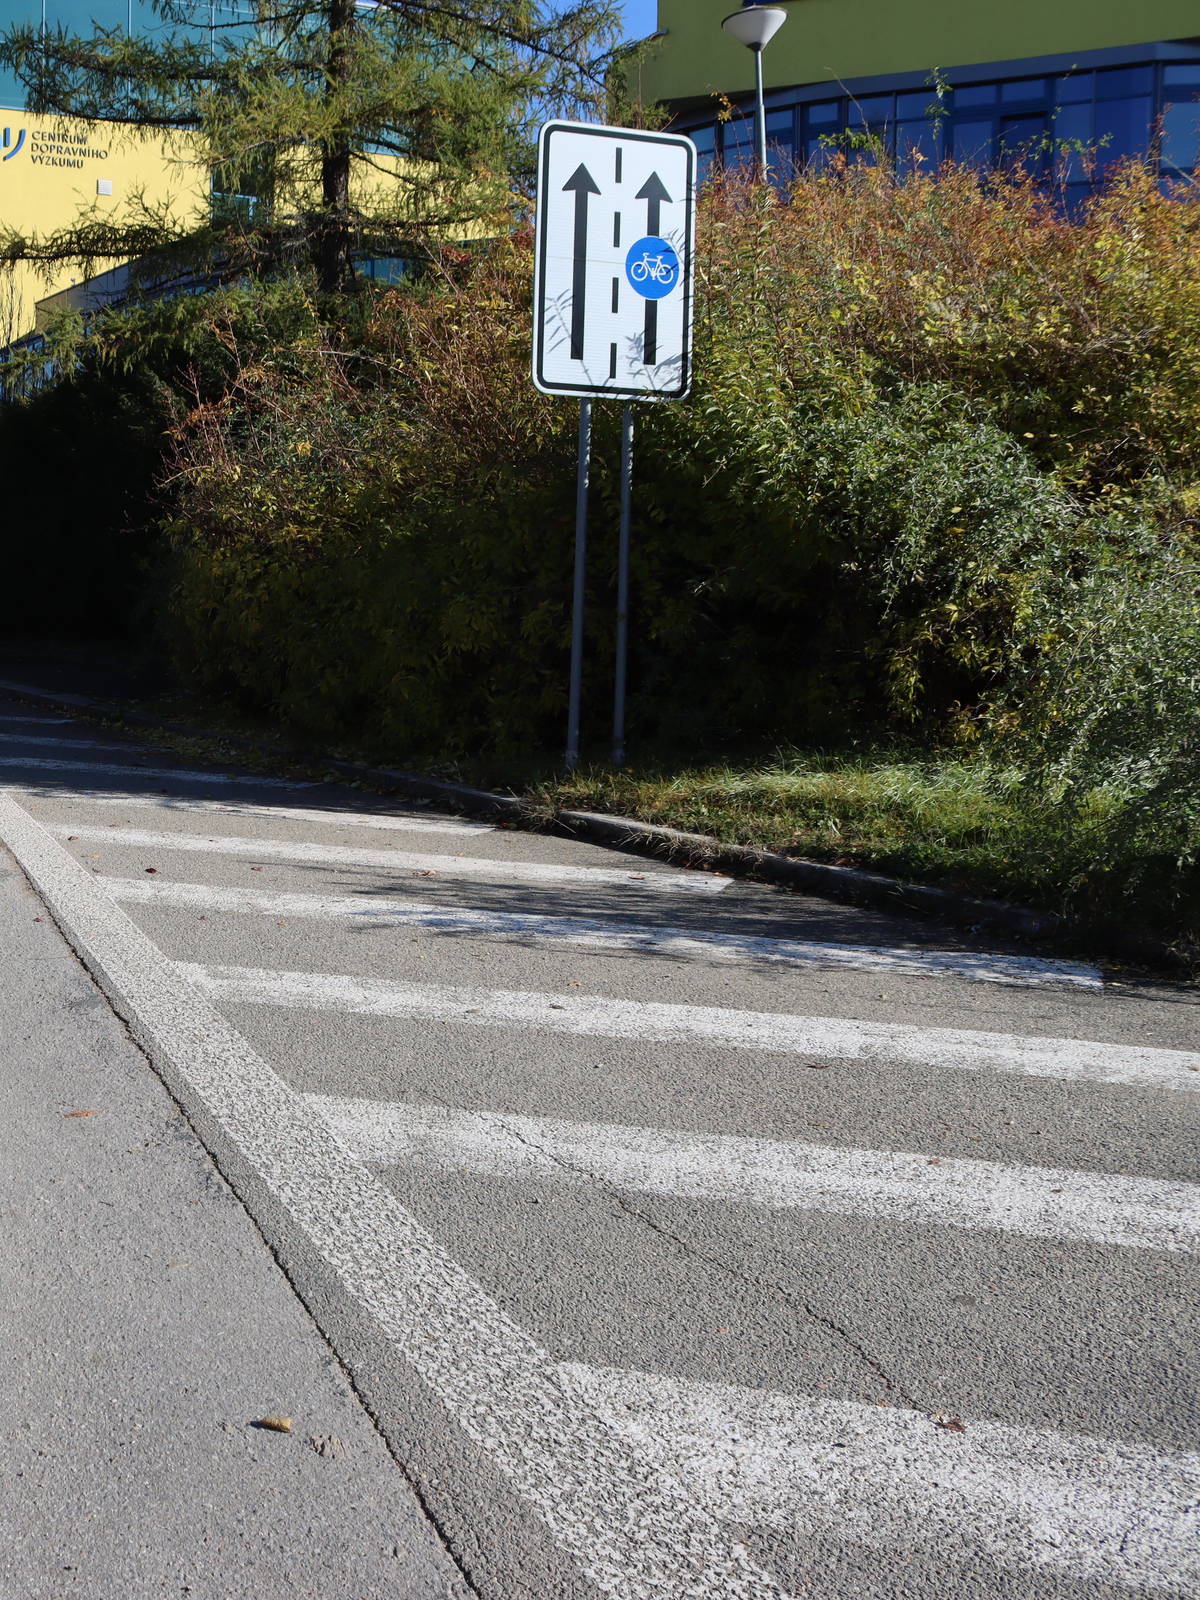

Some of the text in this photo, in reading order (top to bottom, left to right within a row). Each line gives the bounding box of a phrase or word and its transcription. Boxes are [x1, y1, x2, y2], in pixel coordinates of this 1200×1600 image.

[31, 131, 87, 145] CENTRUM
[31, 142, 108, 159] DOPRAVNÍHO
[31, 152, 83, 169] VÝZKUMU
